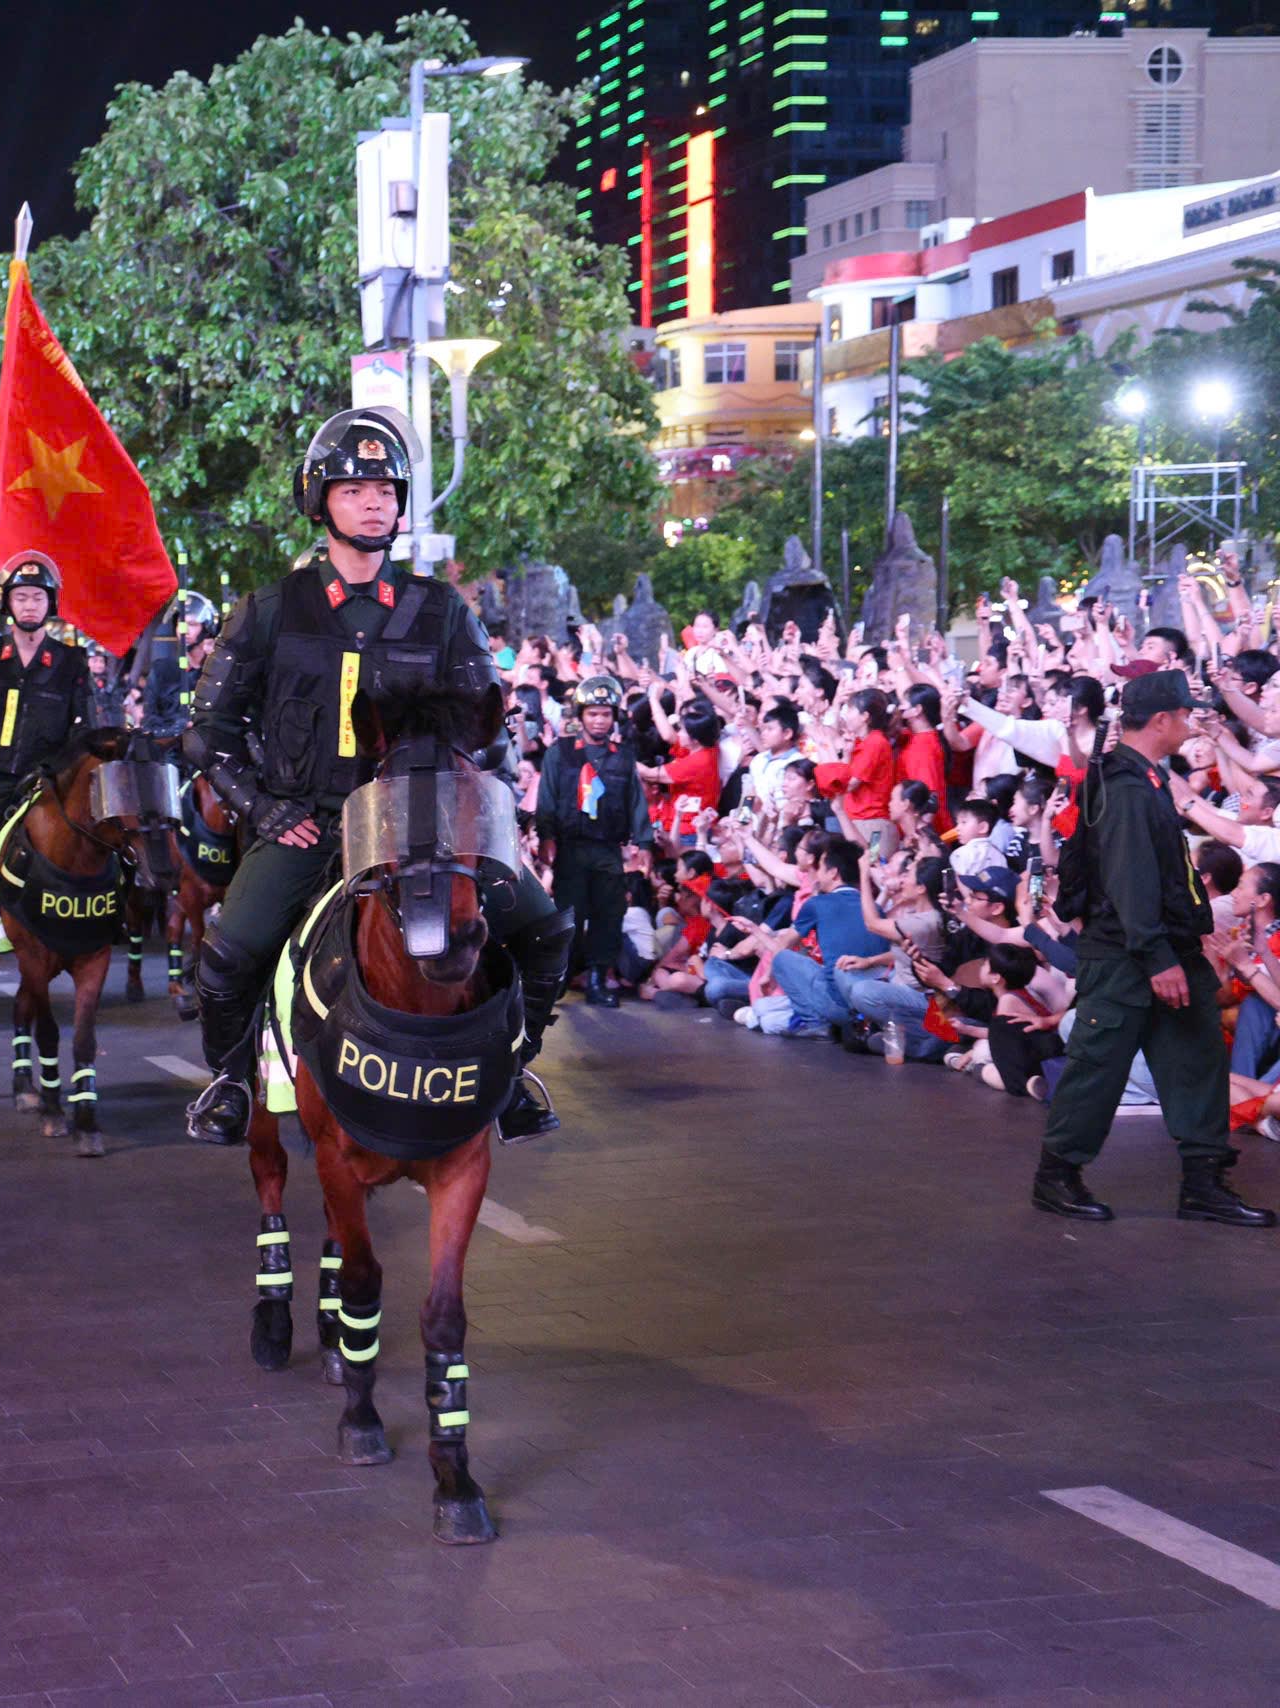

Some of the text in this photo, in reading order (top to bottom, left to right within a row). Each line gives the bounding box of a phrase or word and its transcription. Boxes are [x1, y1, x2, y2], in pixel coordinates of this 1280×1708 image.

[198, 843, 230, 864] POL
[41, 891, 117, 918] POLICE
[338, 1038, 479, 1103] POLICE
